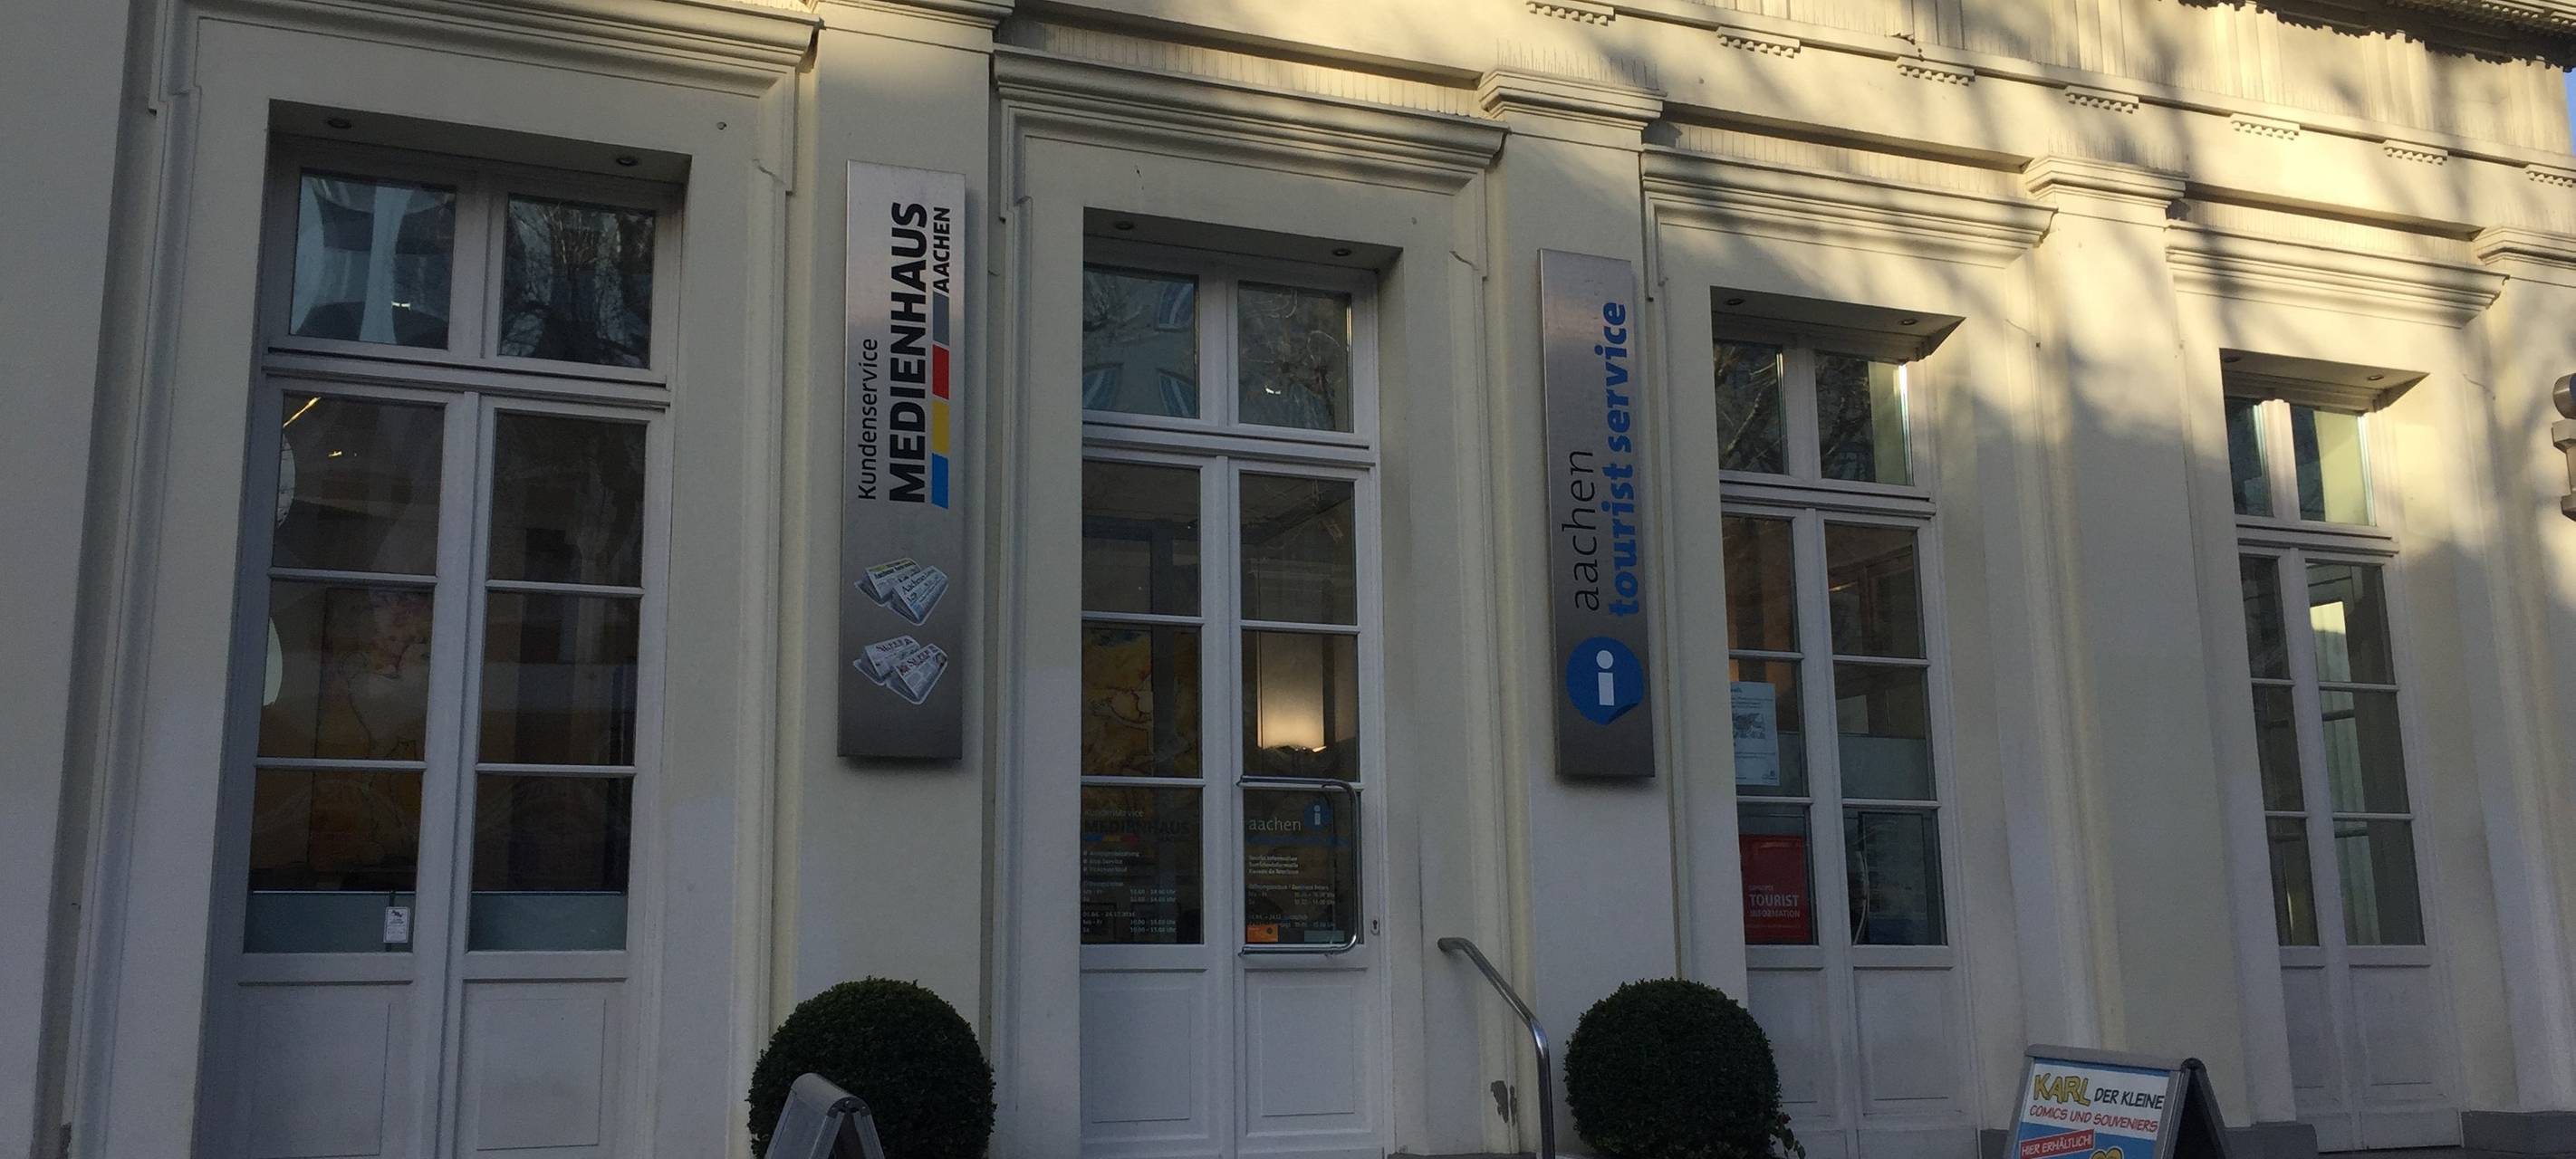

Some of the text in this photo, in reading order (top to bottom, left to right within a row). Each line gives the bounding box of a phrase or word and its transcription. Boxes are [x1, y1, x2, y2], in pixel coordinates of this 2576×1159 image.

[933, 206, 950, 293] AACHEN
[889, 202, 928, 503] MEDIENHAUS
[859, 340, 877, 501] Kundenservice
[1594, 302, 1639, 618] tourist service
[1562, 450, 1600, 612] aachen
[1248, 816, 1302, 831] aachen
[1749, 894, 1800, 907] TOURIST
[2030, 1105, 2158, 1132] COMICS UND SOUVENIERS
[2033, 1072, 2165, 1110] KARL DER KLEINE
[2022, 1143, 2040, 1156] HIER
